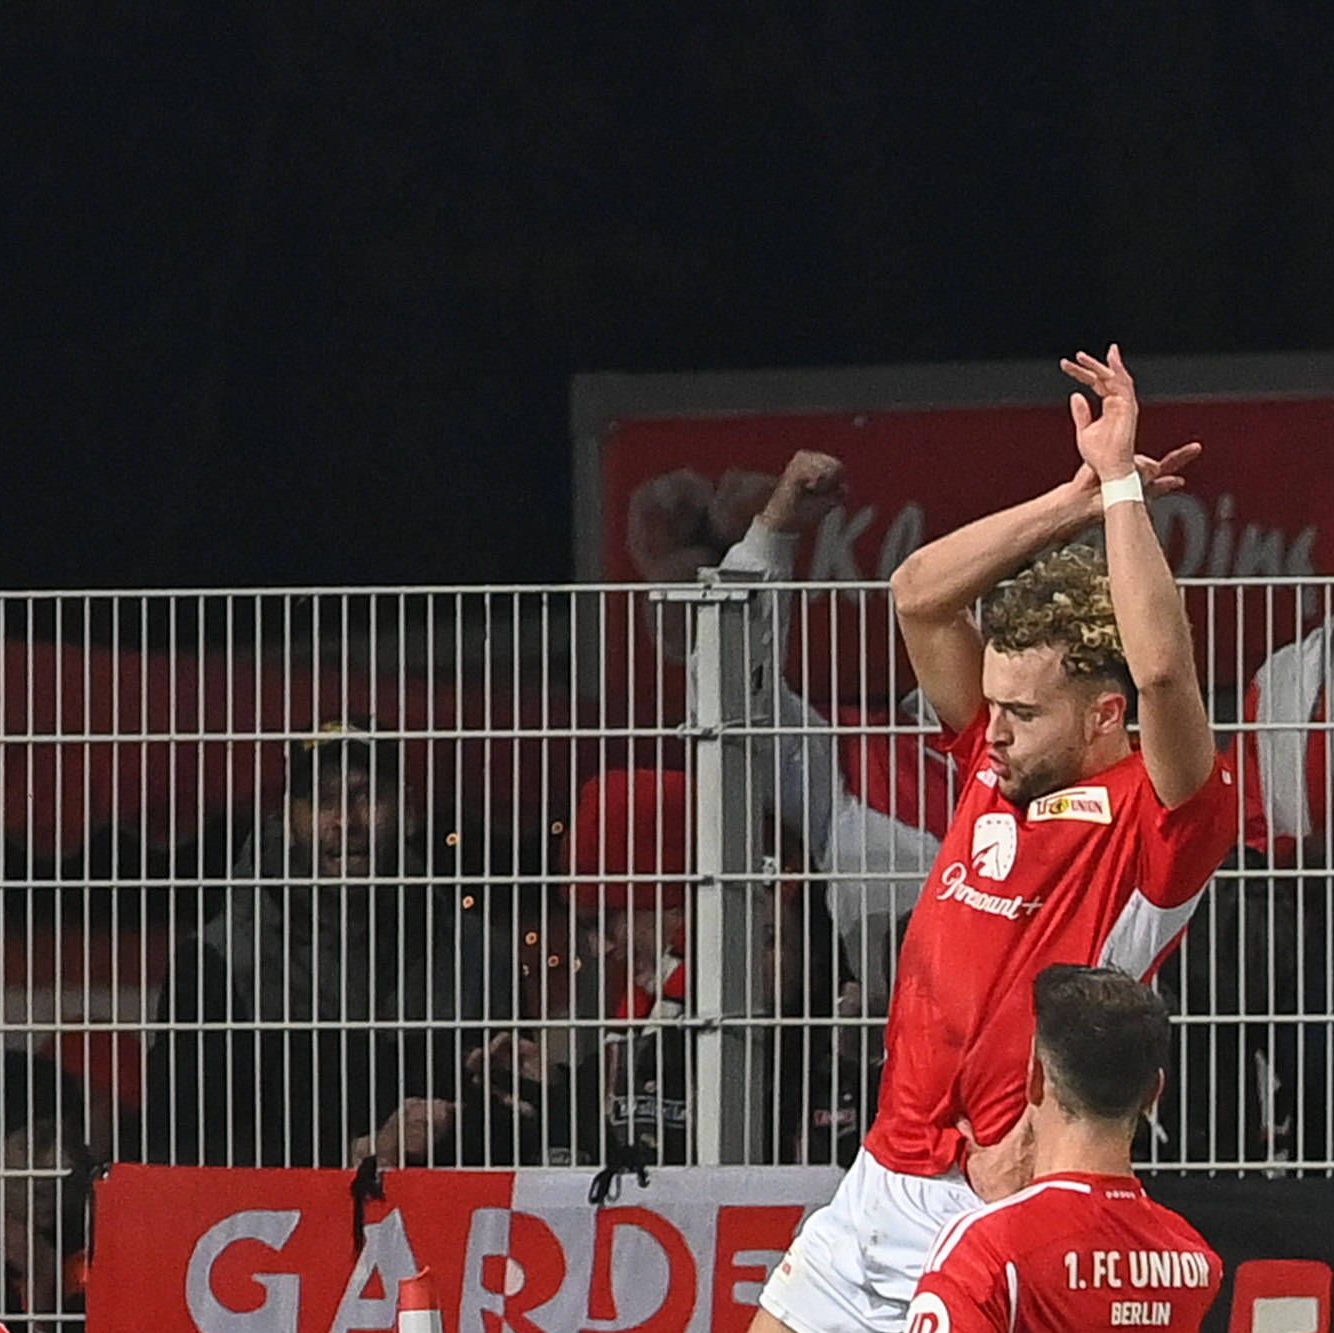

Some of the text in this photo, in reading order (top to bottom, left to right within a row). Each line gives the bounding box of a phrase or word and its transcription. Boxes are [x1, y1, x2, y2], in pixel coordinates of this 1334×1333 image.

[1064, 1251, 1210, 1289] 1. FC UNION
[1111, 1301, 1171, 1326] BERLIN
